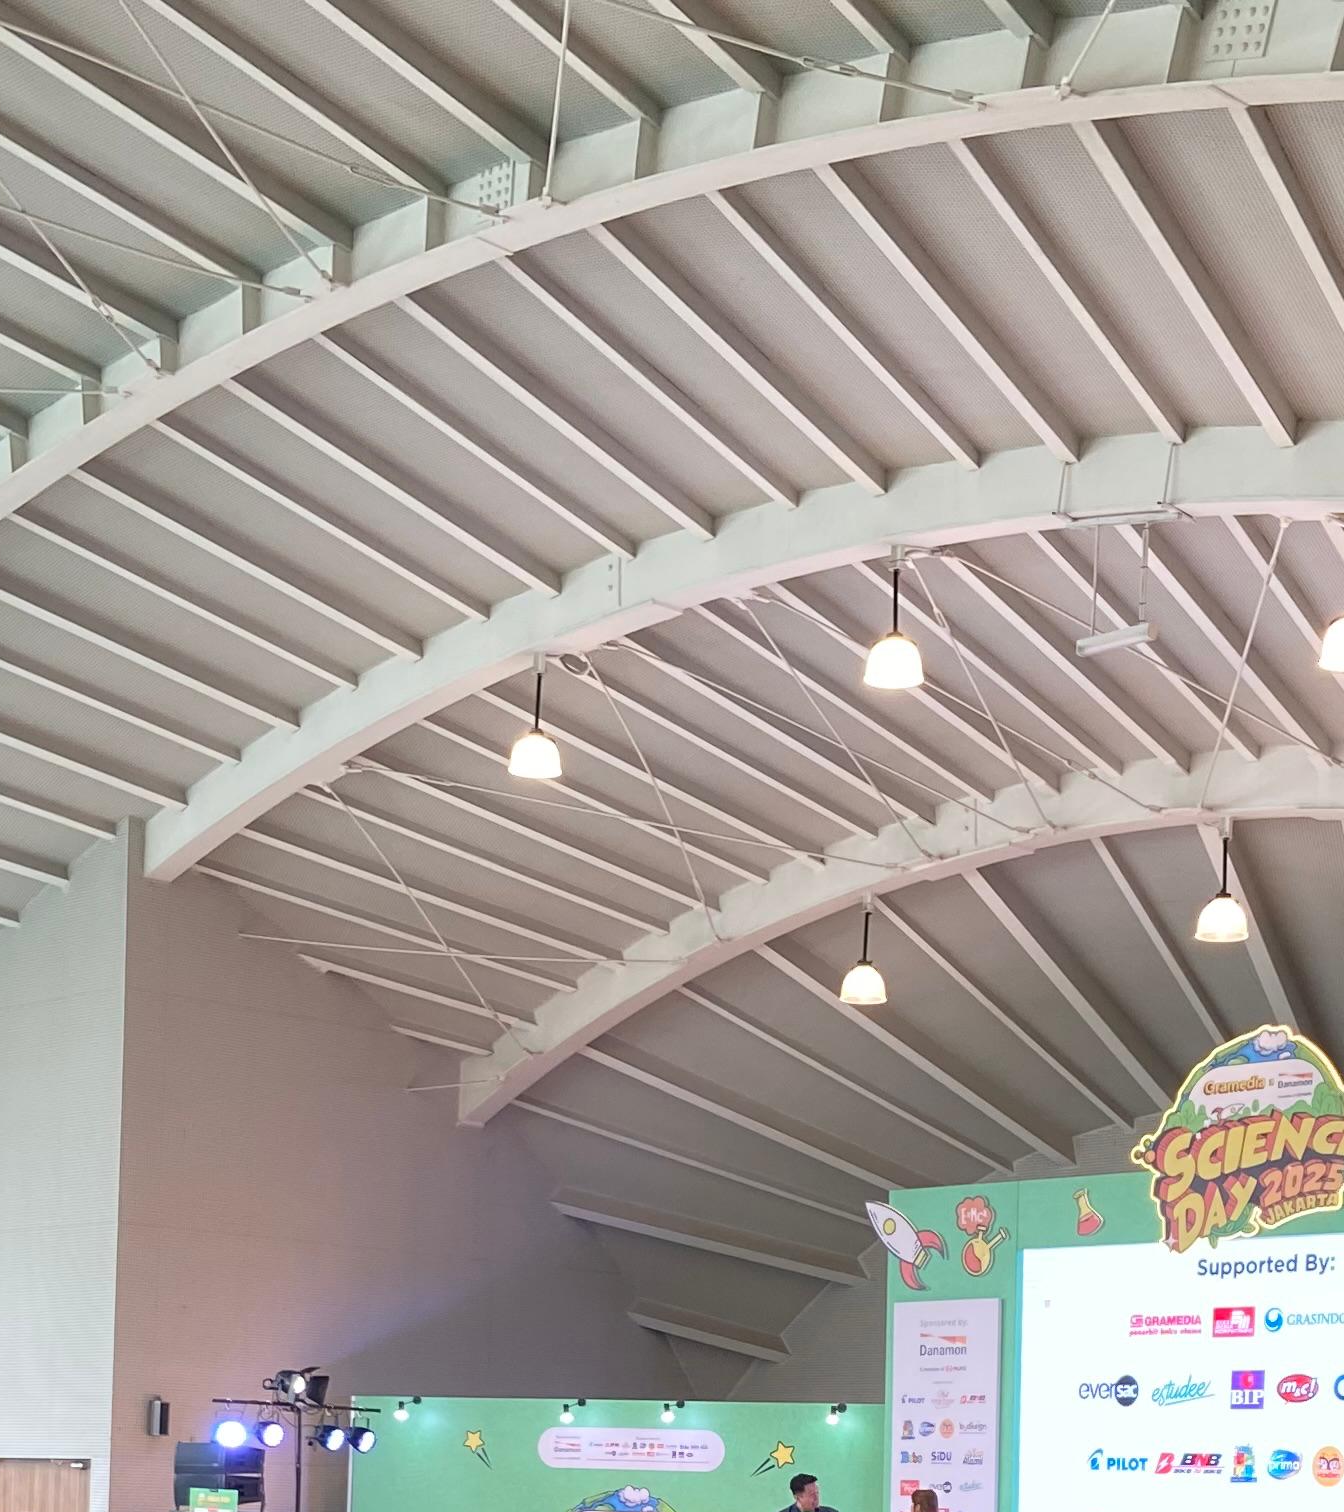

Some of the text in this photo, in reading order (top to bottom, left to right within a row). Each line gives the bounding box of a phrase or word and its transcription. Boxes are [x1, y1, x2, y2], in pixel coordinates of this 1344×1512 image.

[1203, 1075, 1266, 1096] Gramedia
[1277, 1077, 1314, 1089] Danamon
[1170, 1174, 1258, 1252] DAY
[1266, 1192, 1340, 1225] JAKARTA
[1197, 1254, 1336, 1280] Supported By:
[1144, 1315, 1202, 1327] GRAMEDIA
[919, 1344, 967, 1356] Danamon
[1151, 1375, 1212, 1406] estudee
[1230, 1390, 1265, 1405] BIP
[1106, 1457, 1149, 1471] PILOT
[1179, 1453, 1223, 1466] BNB
[1268, 1459, 1301, 1473] prima
